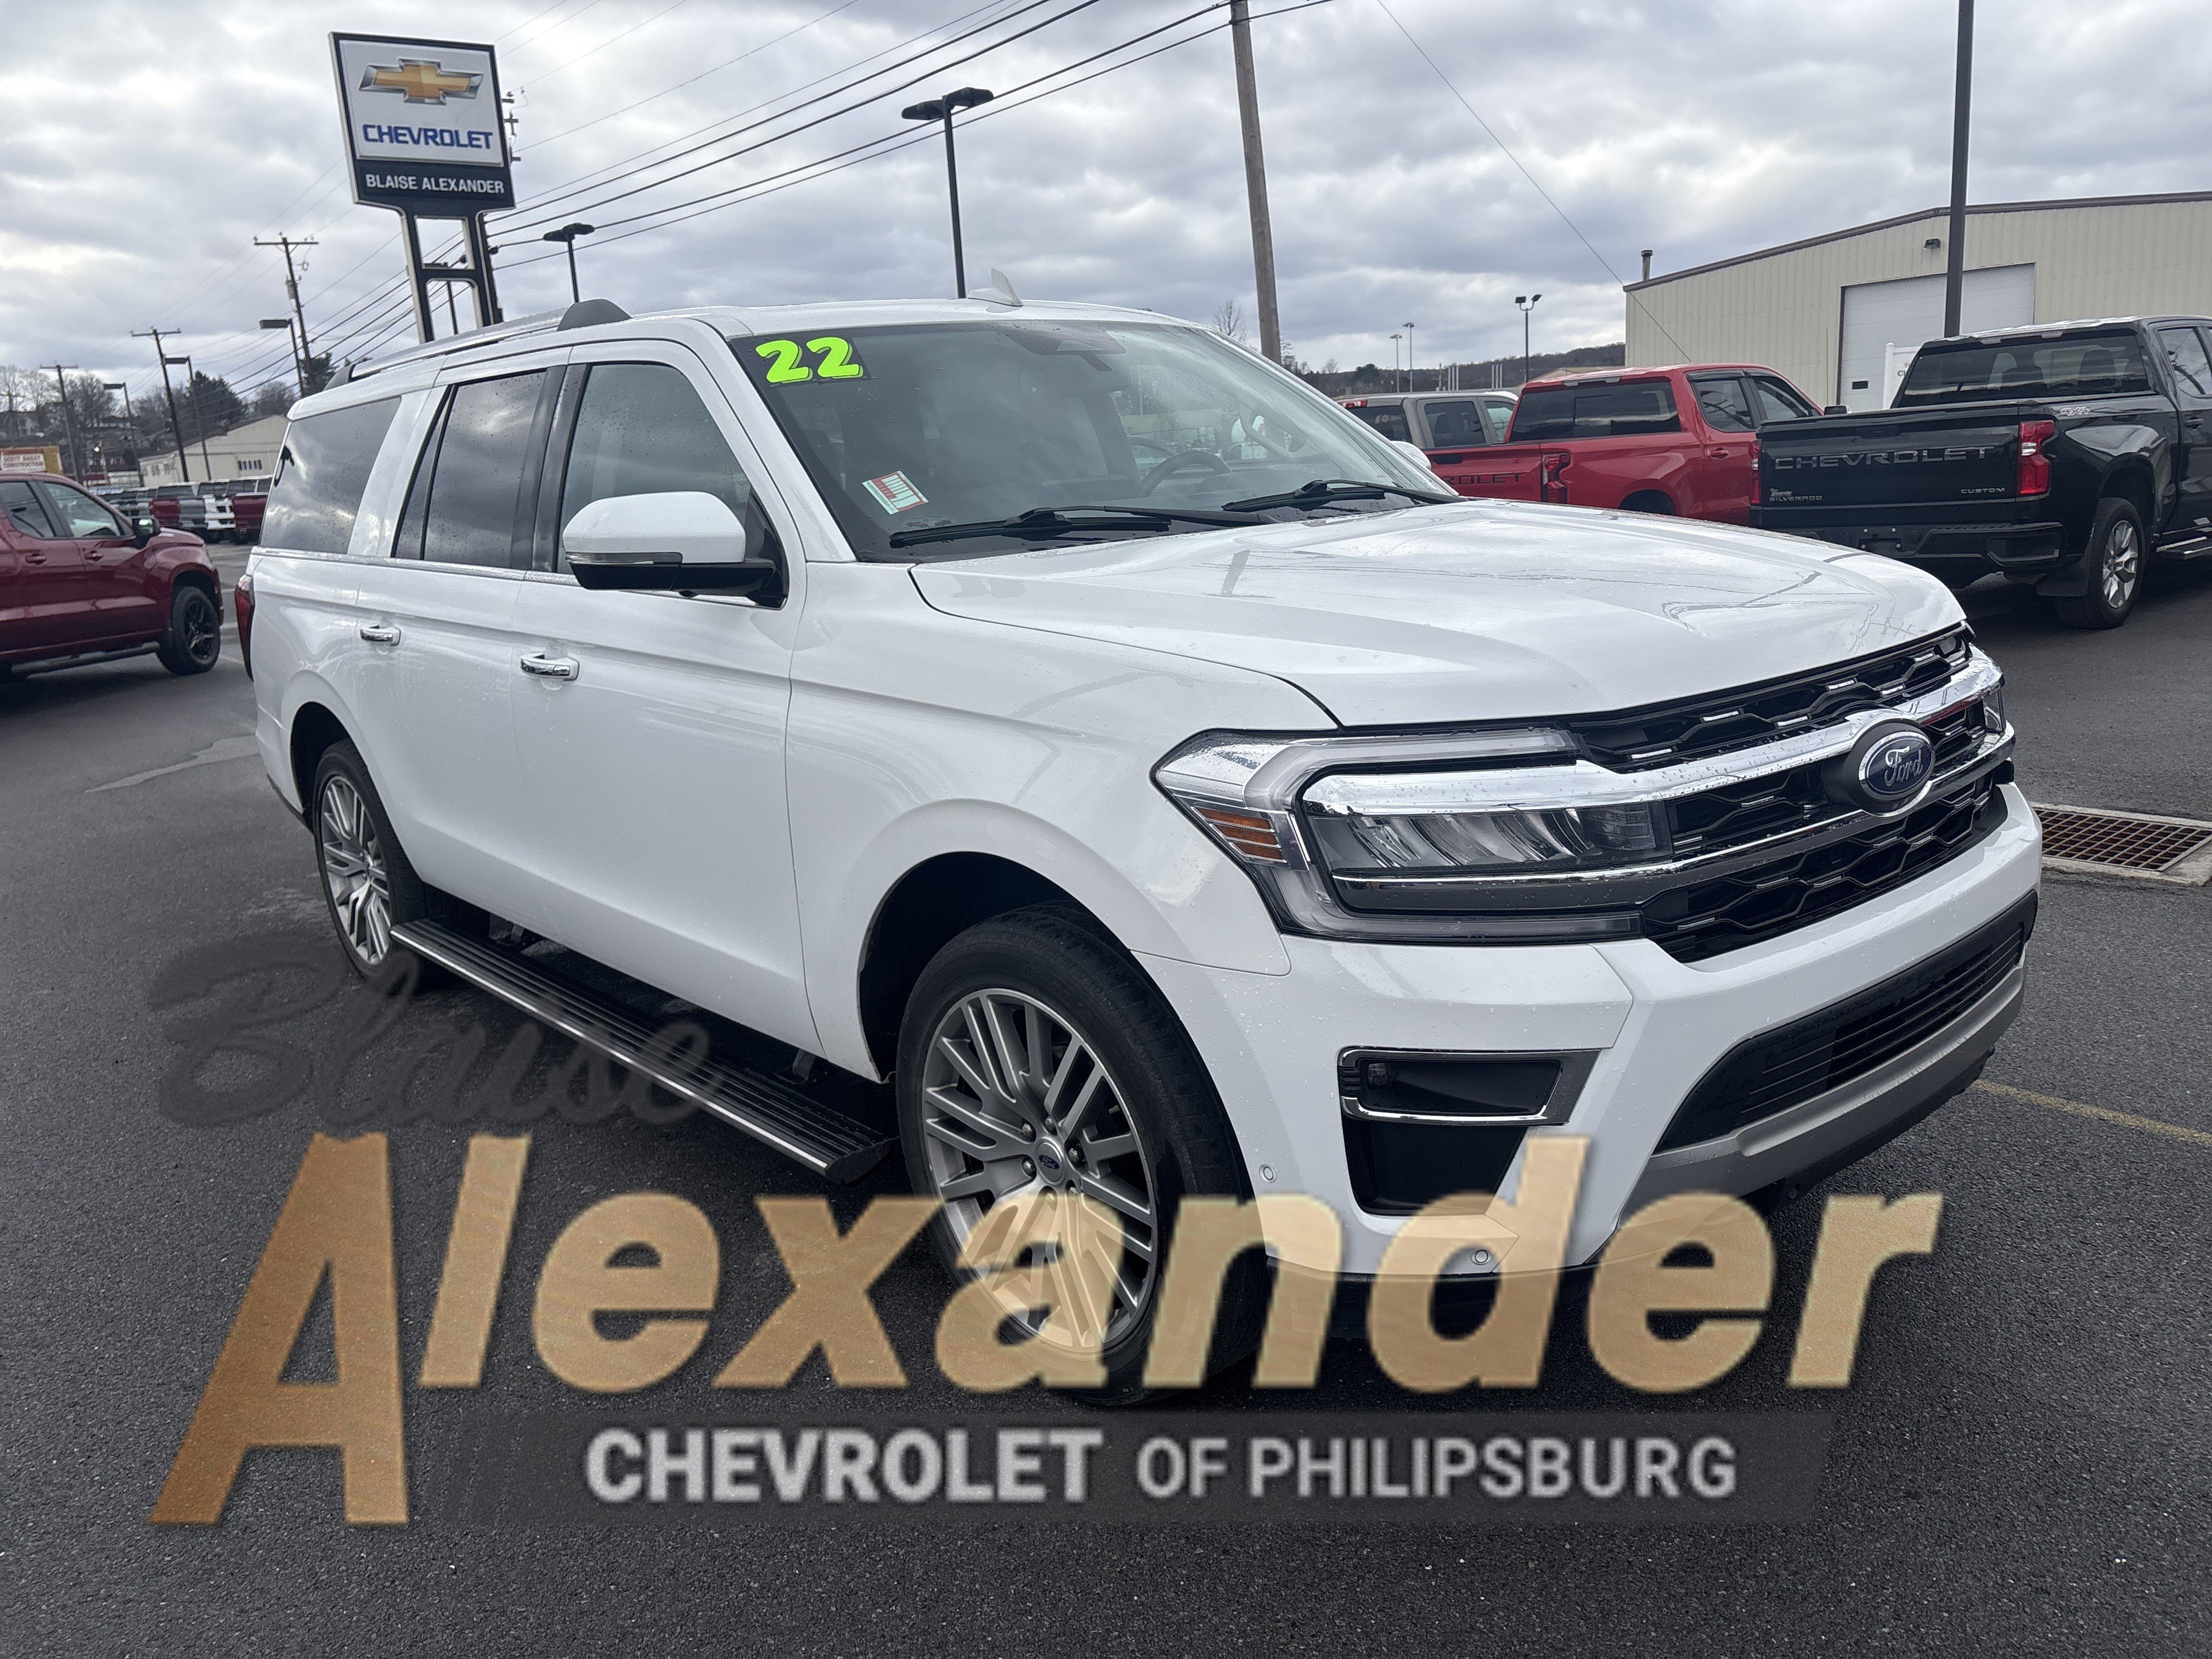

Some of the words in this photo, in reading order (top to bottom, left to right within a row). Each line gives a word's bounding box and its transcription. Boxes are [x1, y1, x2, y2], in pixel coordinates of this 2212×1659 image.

[363, 124, 493, 150] CHEVROLET
[365, 173, 419, 190] BLAISE
[421, 177, 504, 194] ALEXANDER
[755, 337, 864, 383] 22
[1775, 445, 1995, 470] CHEVROLET
[1884, 746, 1923, 786] Ford
